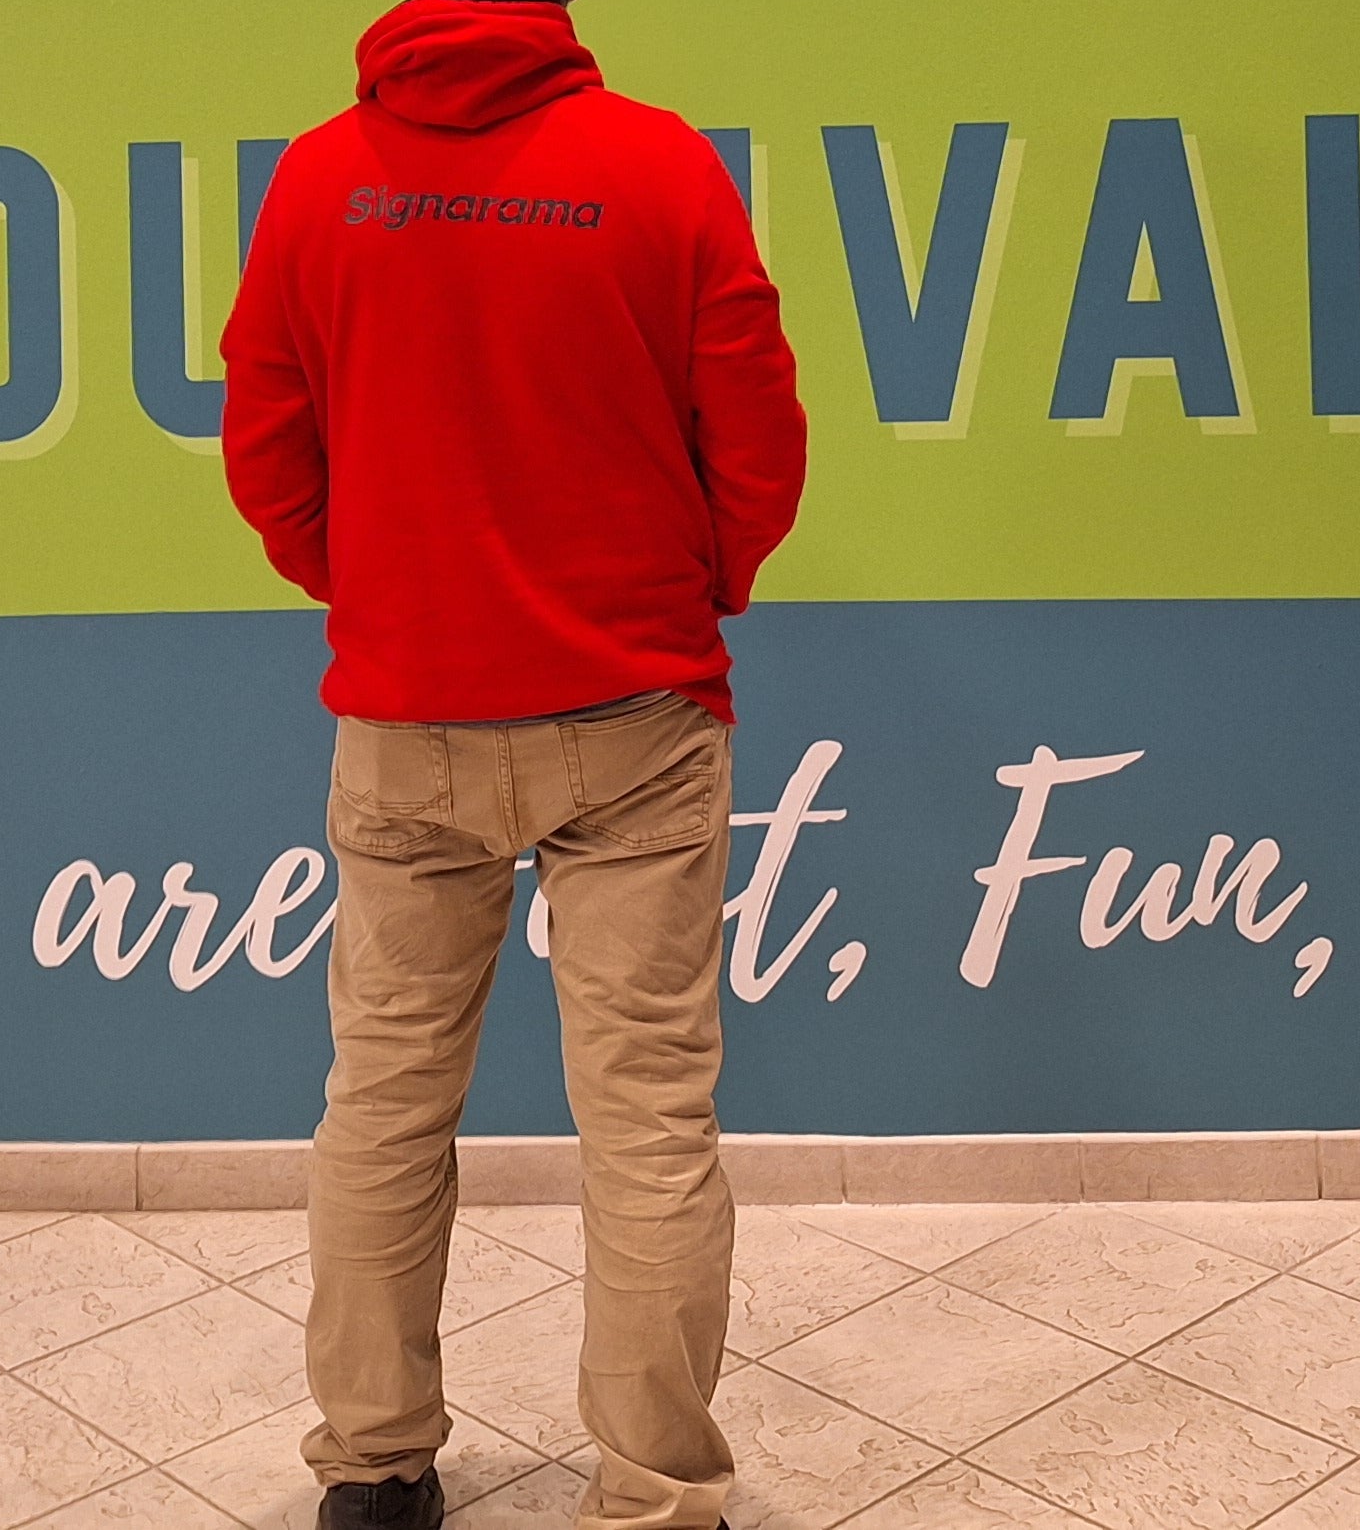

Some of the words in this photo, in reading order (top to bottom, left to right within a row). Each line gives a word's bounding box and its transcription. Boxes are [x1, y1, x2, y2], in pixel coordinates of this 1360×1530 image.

[343, 184, 606, 231] Signarama
[31, 845, 335, 999] are
[958, 742, 1335, 999] Fun,
